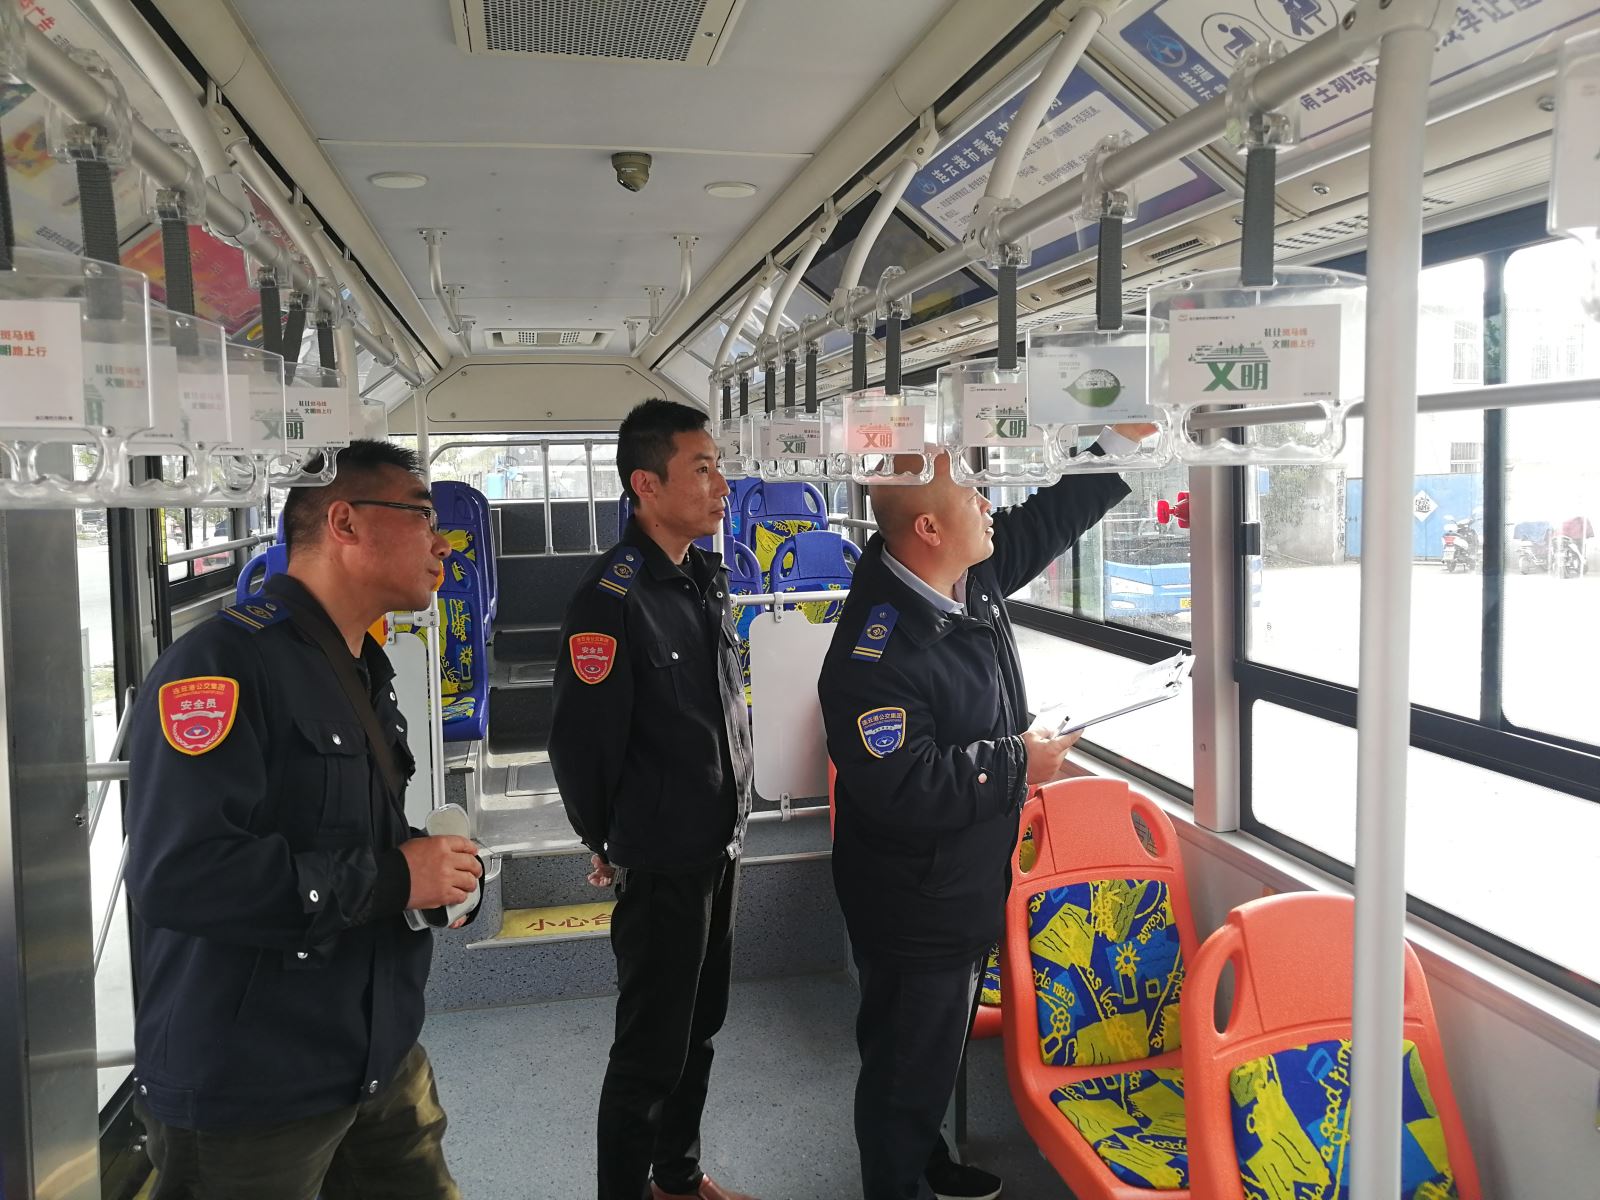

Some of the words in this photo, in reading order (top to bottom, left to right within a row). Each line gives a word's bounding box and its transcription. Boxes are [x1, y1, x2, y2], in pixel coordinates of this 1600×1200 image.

[1199, 355, 1270, 392] 文明
[181, 698, 216, 711] 安全员
